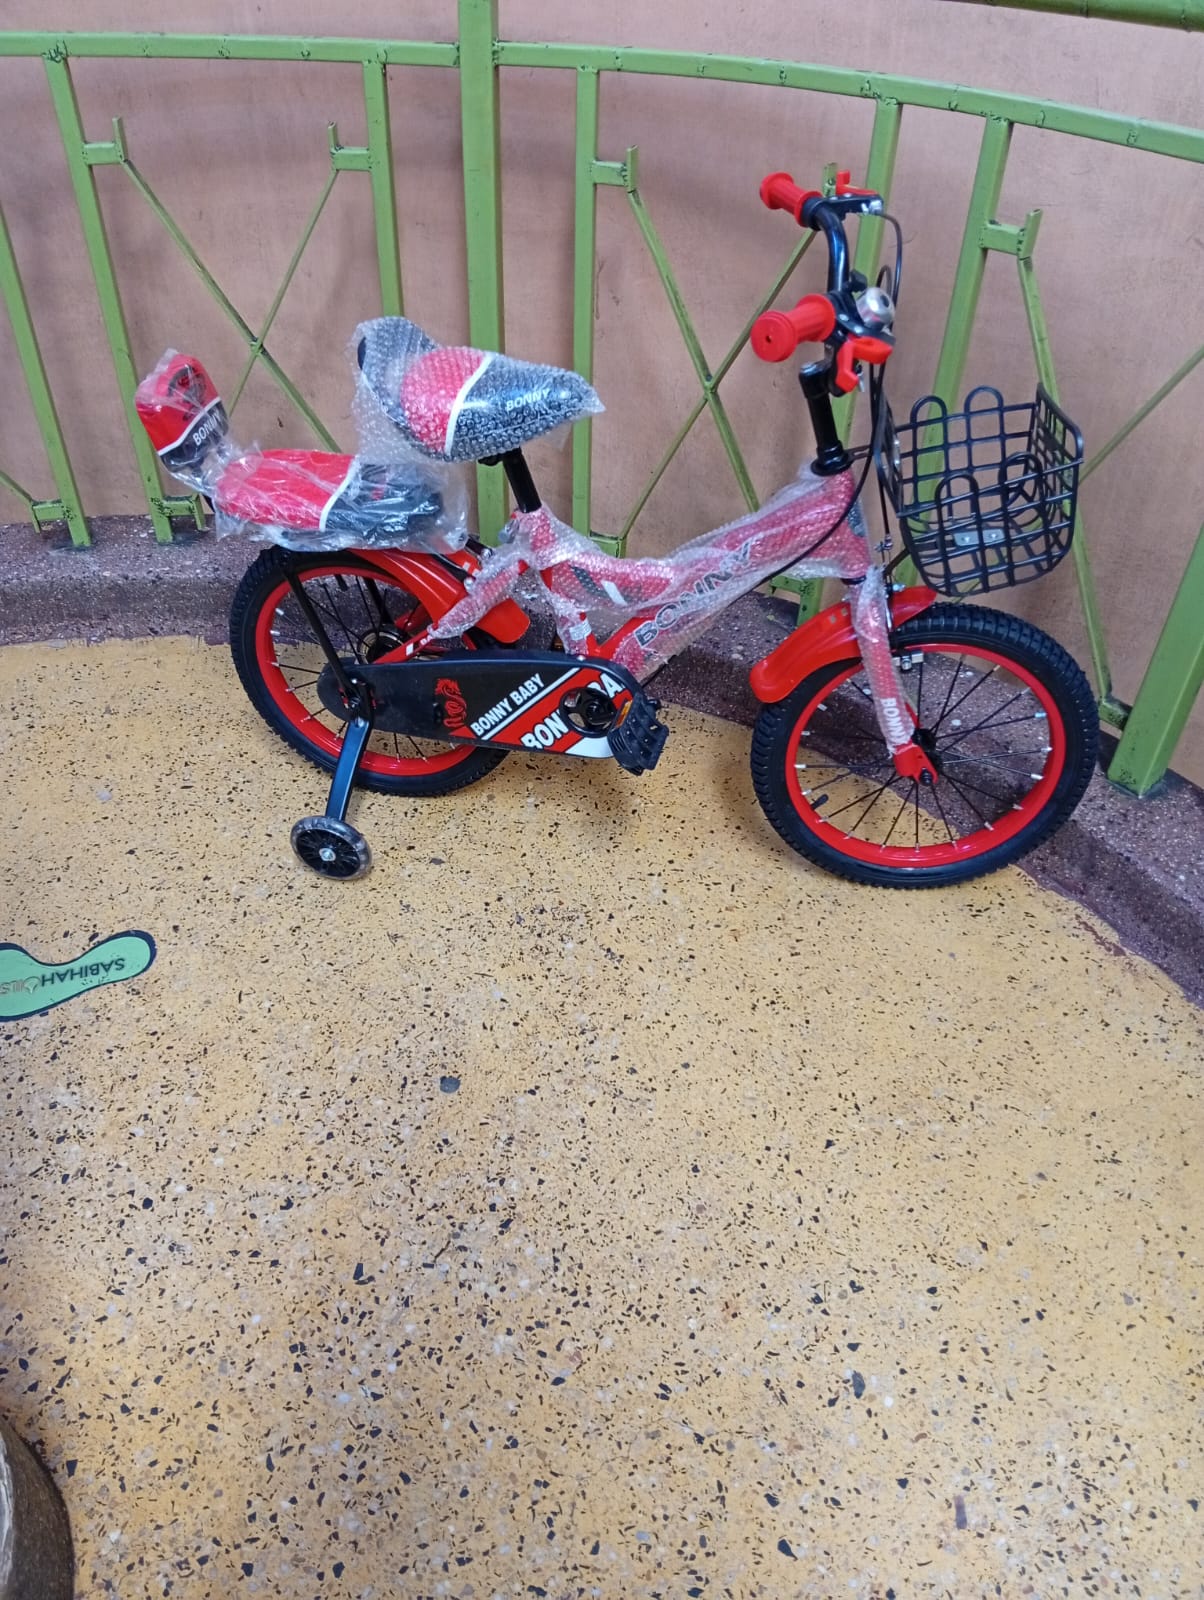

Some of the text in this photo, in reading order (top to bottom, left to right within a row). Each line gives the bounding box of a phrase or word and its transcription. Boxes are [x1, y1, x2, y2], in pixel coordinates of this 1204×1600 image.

[506, 388, 551, 411] BONNY
[192, 411, 223, 446] BONNY
[634, 540, 752, 648] BONNY
[470, 673, 545, 737] BONNY BABY
[520, 709, 570, 750] BON
[41, 957, 126, 987] SABIHAH
